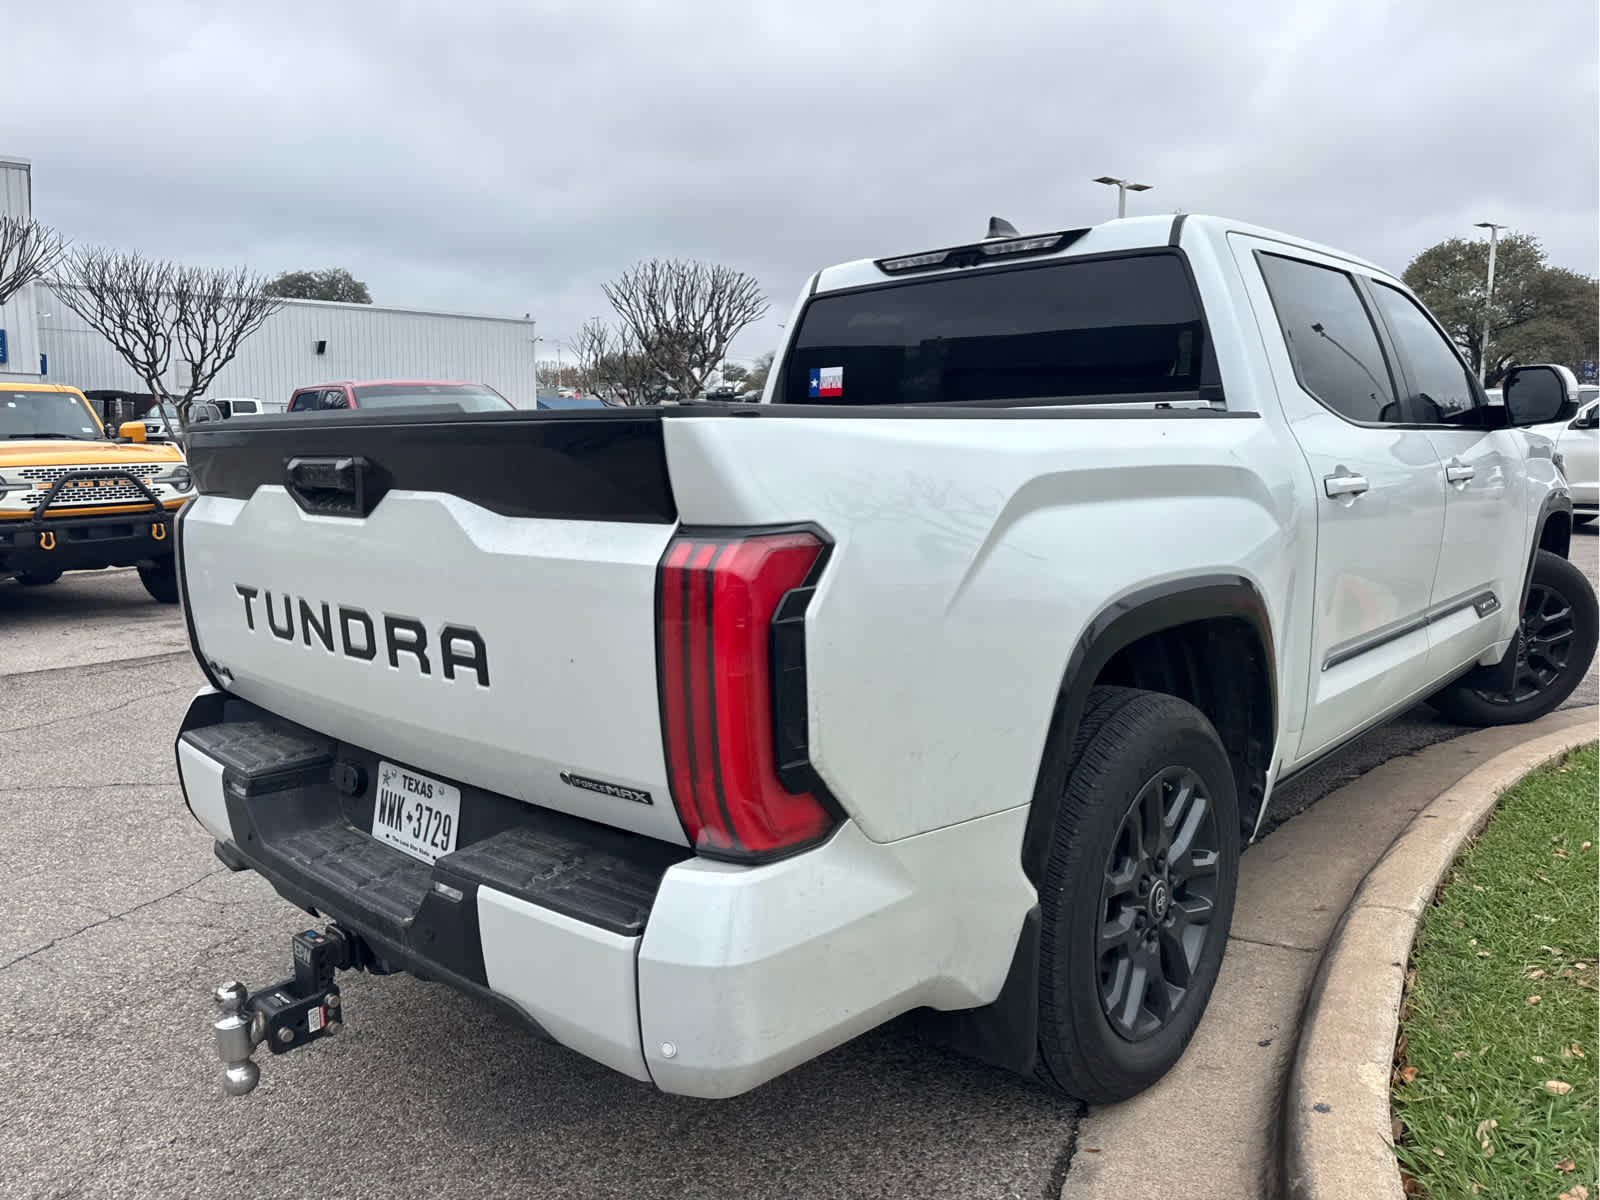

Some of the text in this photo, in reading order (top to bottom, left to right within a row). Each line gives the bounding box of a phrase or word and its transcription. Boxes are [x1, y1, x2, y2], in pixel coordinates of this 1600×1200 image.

[234, 582, 491, 688] TUNDRA
[402, 774, 434, 799] TEXAS
[378, 788, 452, 851] WWK 3729
